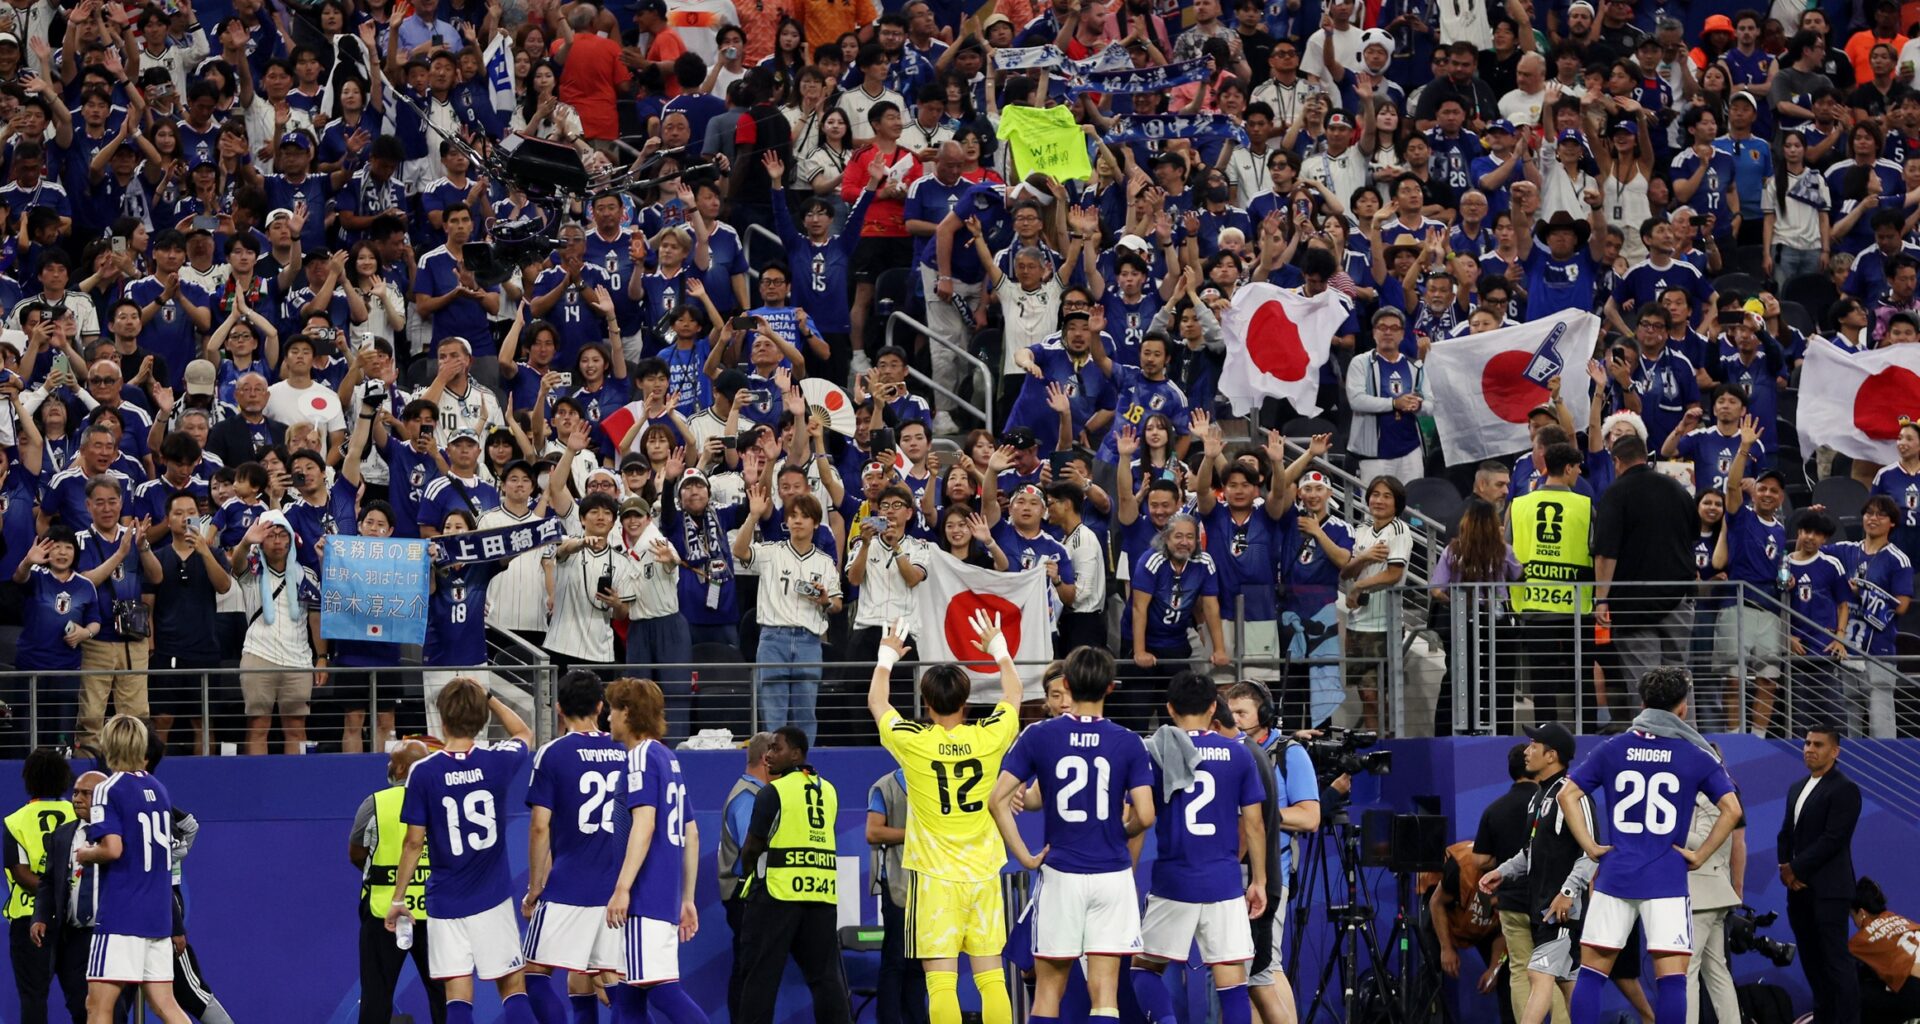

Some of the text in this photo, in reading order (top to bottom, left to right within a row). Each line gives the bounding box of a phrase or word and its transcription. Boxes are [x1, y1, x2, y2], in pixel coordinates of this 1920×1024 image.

[1449, 171, 1467, 187] 26
[1706, 192, 1721, 210] 17
[812, 273, 826, 292] 15
[564, 305, 580, 322] 14
[441, 412, 457, 430] 10
[1123, 402, 1144, 424] 18
[331, 539, 424, 562] 各務原の星
[455, 520, 559, 562] 上田綺世
[1536, 549, 1561, 557] 2026
[780, 577, 790, 596] 7
[323, 590, 428, 620] 鈴木淳之介
[451, 603, 467, 623] 18
[938, 742, 972, 756] OSAKO
[1194, 748, 1231, 762] WARA
[1626, 747, 1673, 763] SHIOGAI
[444, 767, 484, 787] OGAWA
[930, 758, 984, 815] 12
[1055, 755, 1111, 823] 21
[1184, 770, 1216, 836] 2
[1613, 769, 1681, 836] 26
[441, 789, 498, 857] 19
[138, 810, 172, 873] 14
